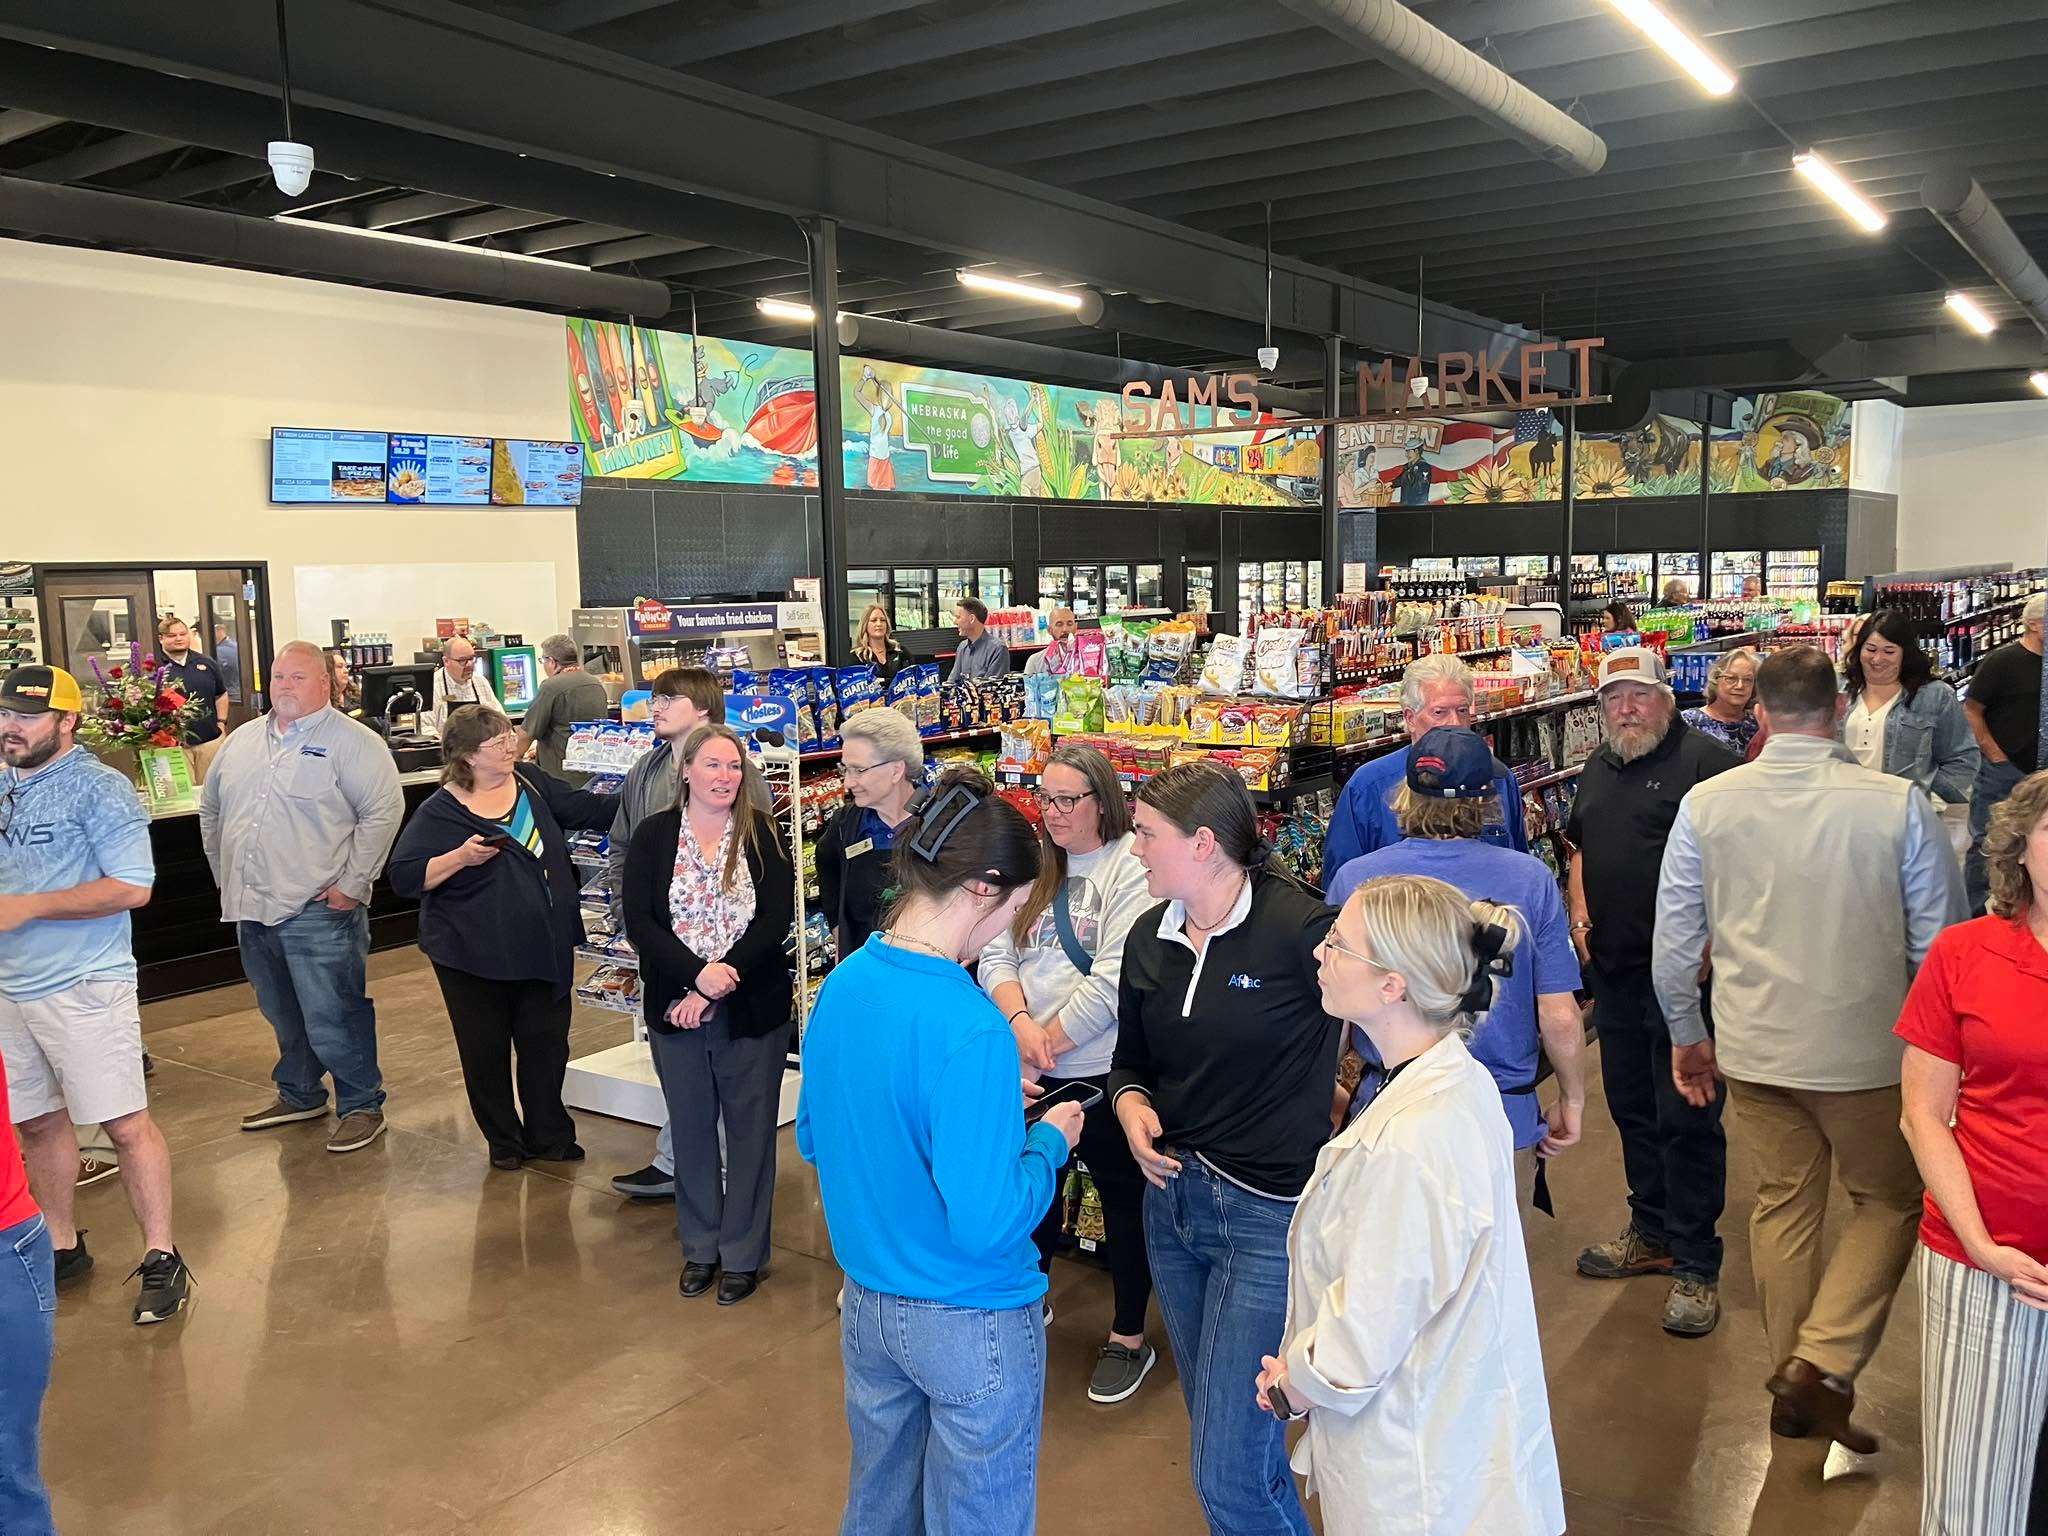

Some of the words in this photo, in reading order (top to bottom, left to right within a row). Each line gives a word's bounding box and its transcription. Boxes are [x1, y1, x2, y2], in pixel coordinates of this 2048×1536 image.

[1121, 373, 1260, 433] SAM'S
[1358, 337, 1605, 418] MARKET
[911, 403, 967, 420] NEBRASKA
[927, 425, 942, 437] the
[945, 428, 968, 442] good
[943, 443, 960, 459] life
[634, 610, 673, 624] KRUNCHY
[677, 615, 695, 628] Your
[696, 613, 726, 627] favorite
[727, 612, 745, 625] fried
[746, 610, 773, 624] chicken
[745, 704, 781, 721] Hostess
